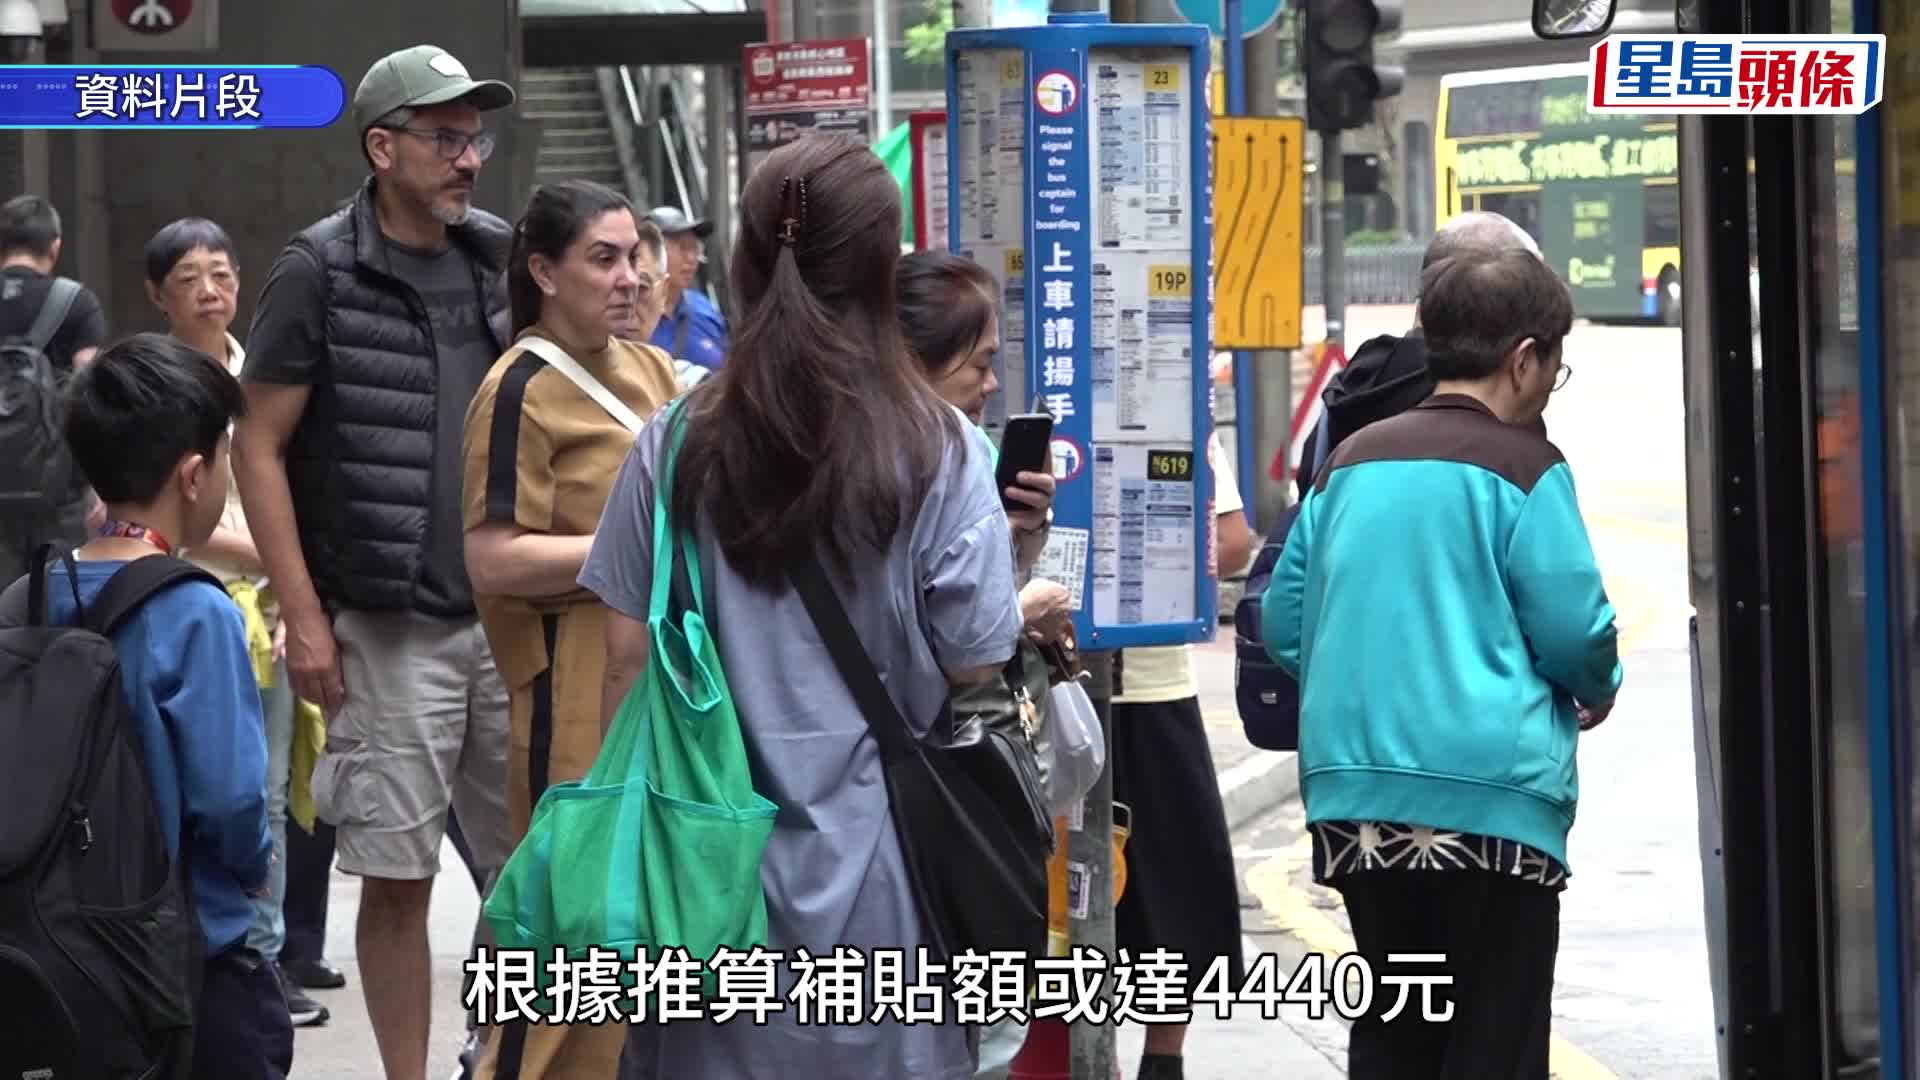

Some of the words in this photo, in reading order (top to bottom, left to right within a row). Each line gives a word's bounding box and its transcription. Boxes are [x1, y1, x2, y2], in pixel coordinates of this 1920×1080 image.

[1154, 71, 1169, 85] 23
[1039, 125, 1074, 135] Please
[1041, 141, 1072, 152] signal
[1048, 157, 1066, 166] the
[1047, 173, 1067, 182] bus
[1038, 188, 1077, 199] captain
[1049, 203, 1065, 213] for
[1036, 220, 1080, 232] boarding
[1155, 271, 1187, 291] 19P
[1042, 241, 1075, 425] 上車請揚手
